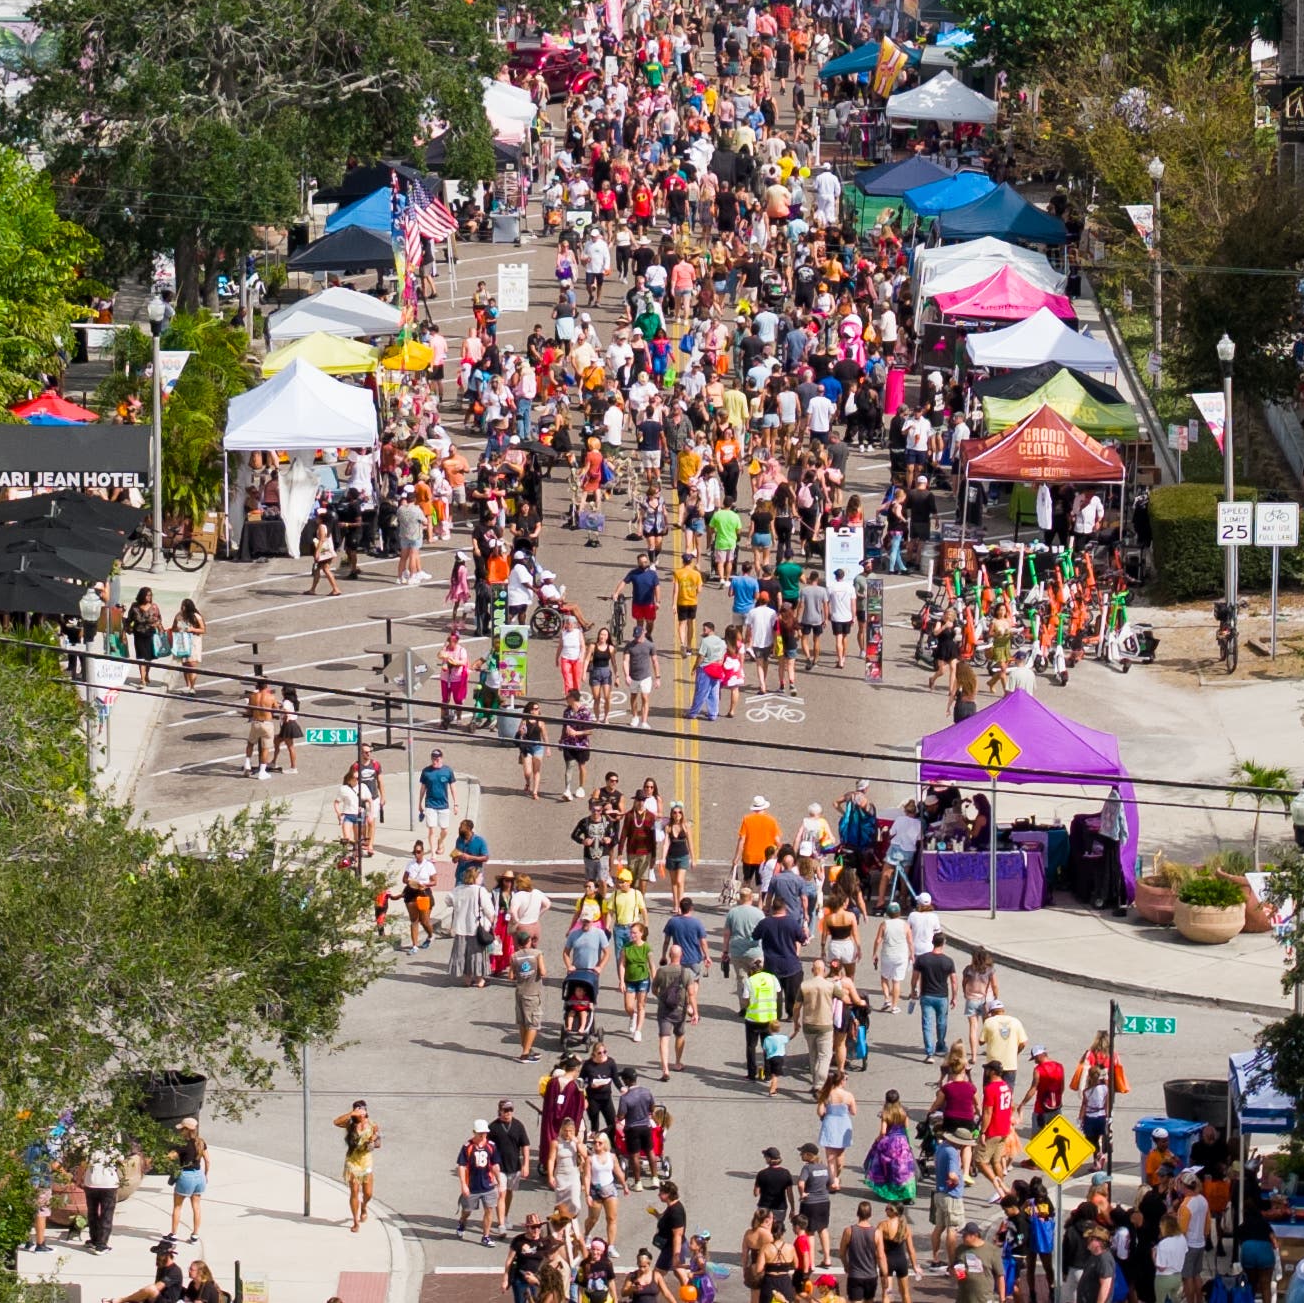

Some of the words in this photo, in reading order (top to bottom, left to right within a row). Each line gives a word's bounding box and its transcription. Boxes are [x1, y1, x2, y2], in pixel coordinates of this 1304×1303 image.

[1023, 427, 1066, 442] GRAND
[1018, 443, 1071, 457] CENTRAL
[34, 471, 80, 487] JEAN
[84, 472, 145, 487] HOTEL
[1222, 507, 1249, 515] SPEED
[1222, 525, 1248, 539] 25
[310, 730, 324, 742] 24
[330, 730, 341, 742] St
[347, 730, 354, 742] N
[1144, 1018, 1157, 1032] St
[1164, 1019, 1172, 1032] S
[1000, 1091, 1011, 1110] 13
[474, 1150, 488, 1167] 18
